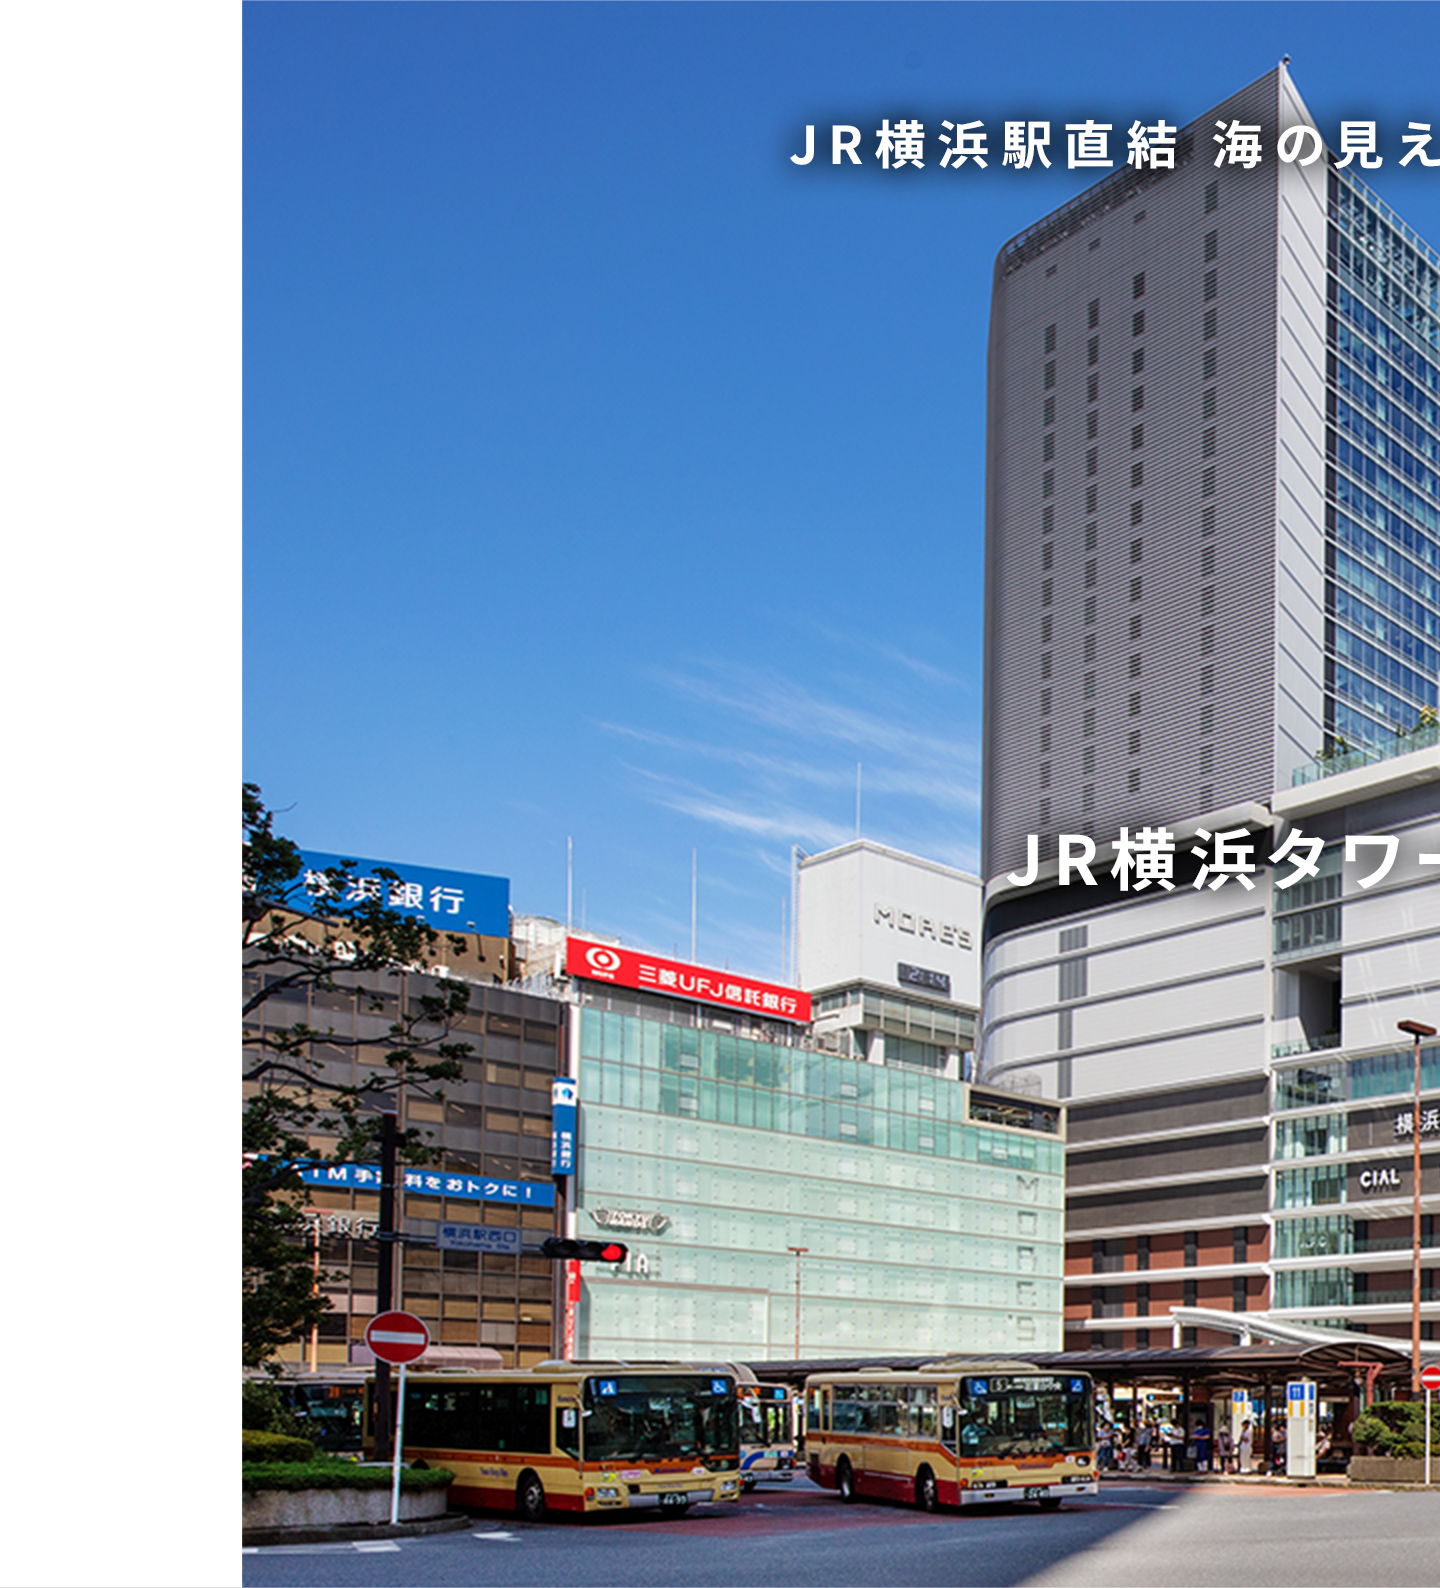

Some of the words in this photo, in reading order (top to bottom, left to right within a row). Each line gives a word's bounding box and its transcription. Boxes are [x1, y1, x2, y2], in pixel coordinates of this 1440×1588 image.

[639, 964, 797, 1014] 三菱UFJ信託銀行
[1359, 1169, 1401, 1188] CIAL
